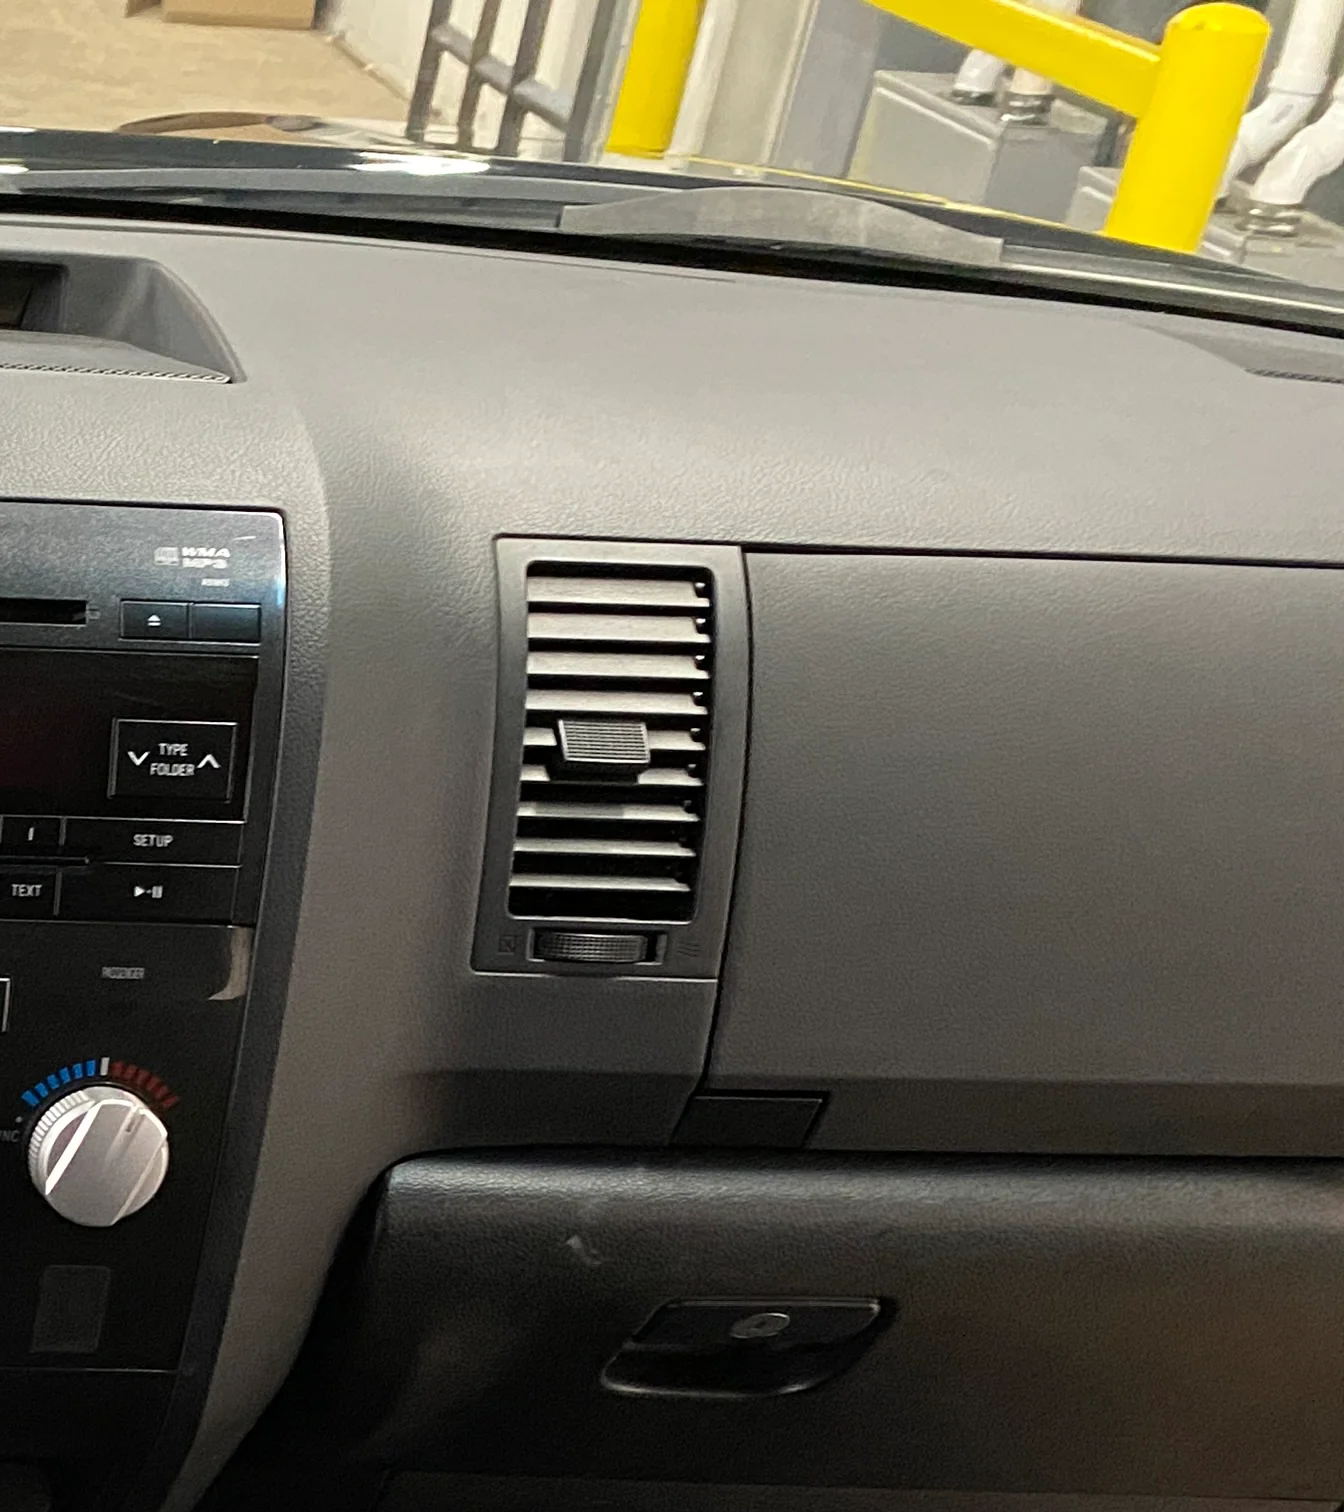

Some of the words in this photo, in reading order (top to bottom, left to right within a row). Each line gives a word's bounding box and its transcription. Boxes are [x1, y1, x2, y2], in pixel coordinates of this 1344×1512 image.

[181, 547, 231, 558] WMA
[158, 742, 189, 757] TYPE
[149, 762, 196, 777] FOLDER
[132, 833, 174, 847] SETUP
[11, 883, 43, 897] TEXT
